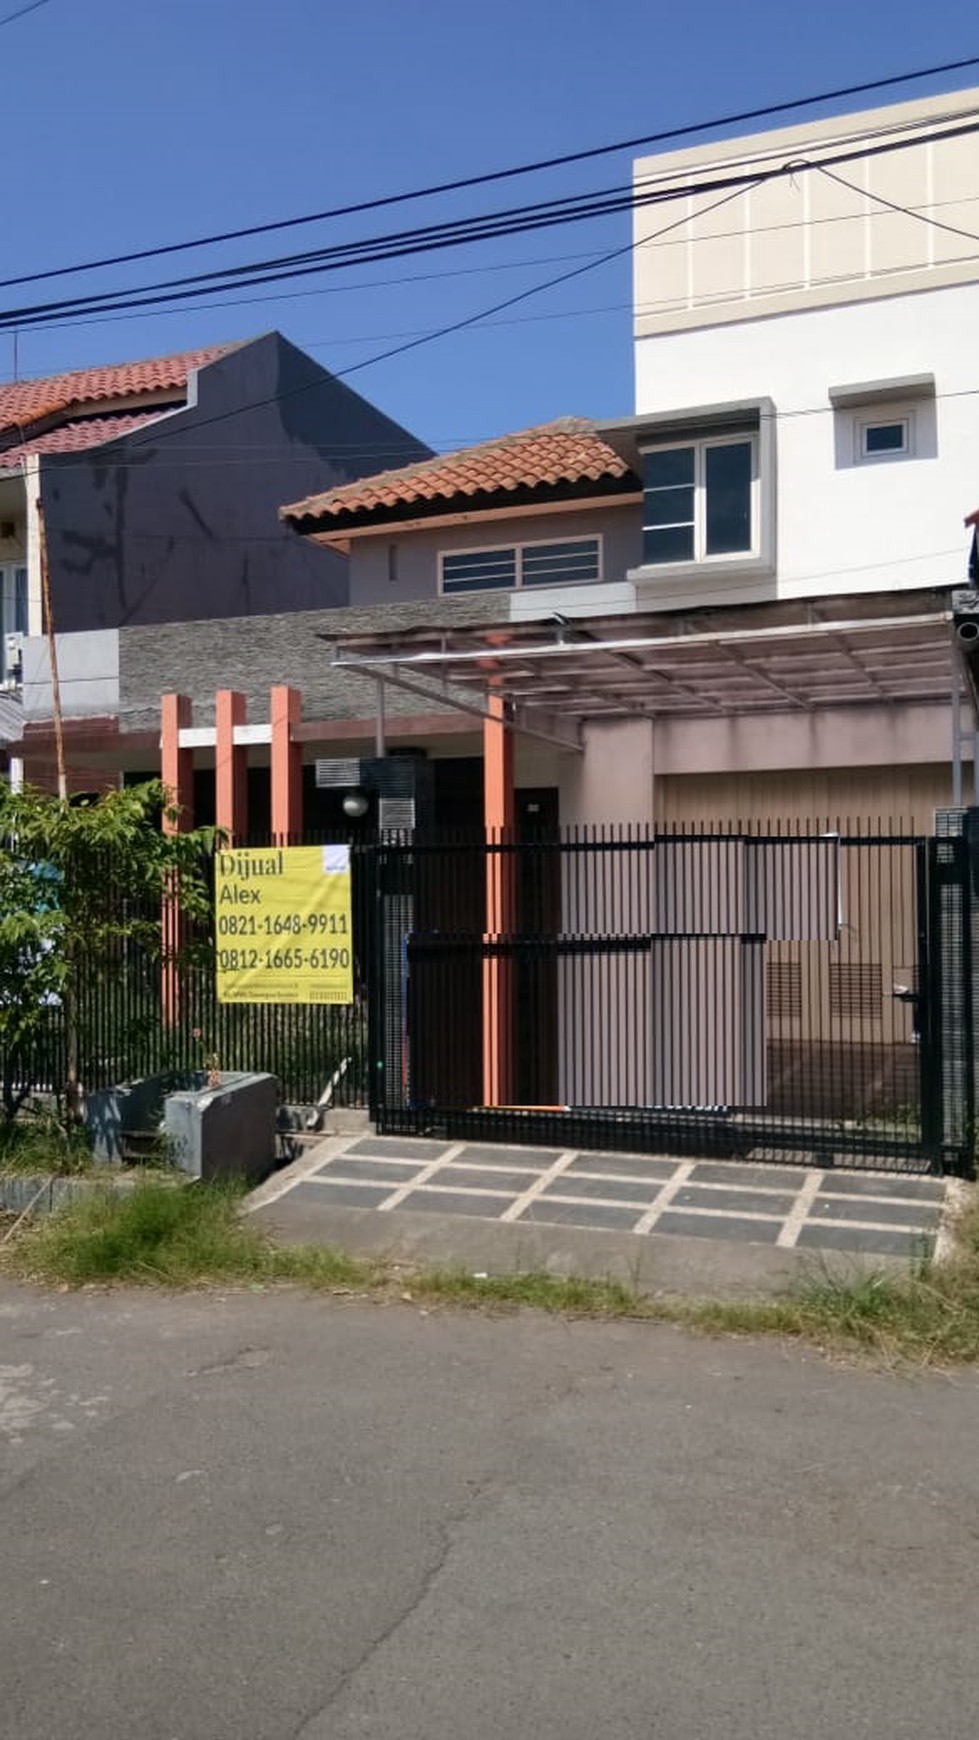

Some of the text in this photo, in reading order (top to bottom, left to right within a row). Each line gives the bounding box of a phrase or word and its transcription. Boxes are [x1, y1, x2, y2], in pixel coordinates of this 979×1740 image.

[219, 850, 284, 881] Dijual
[219, 883, 261, 905] Alex
[219, 913, 348, 936] 0821-1648-9911
[219, 947, 350, 969] 0812-1665-6190
